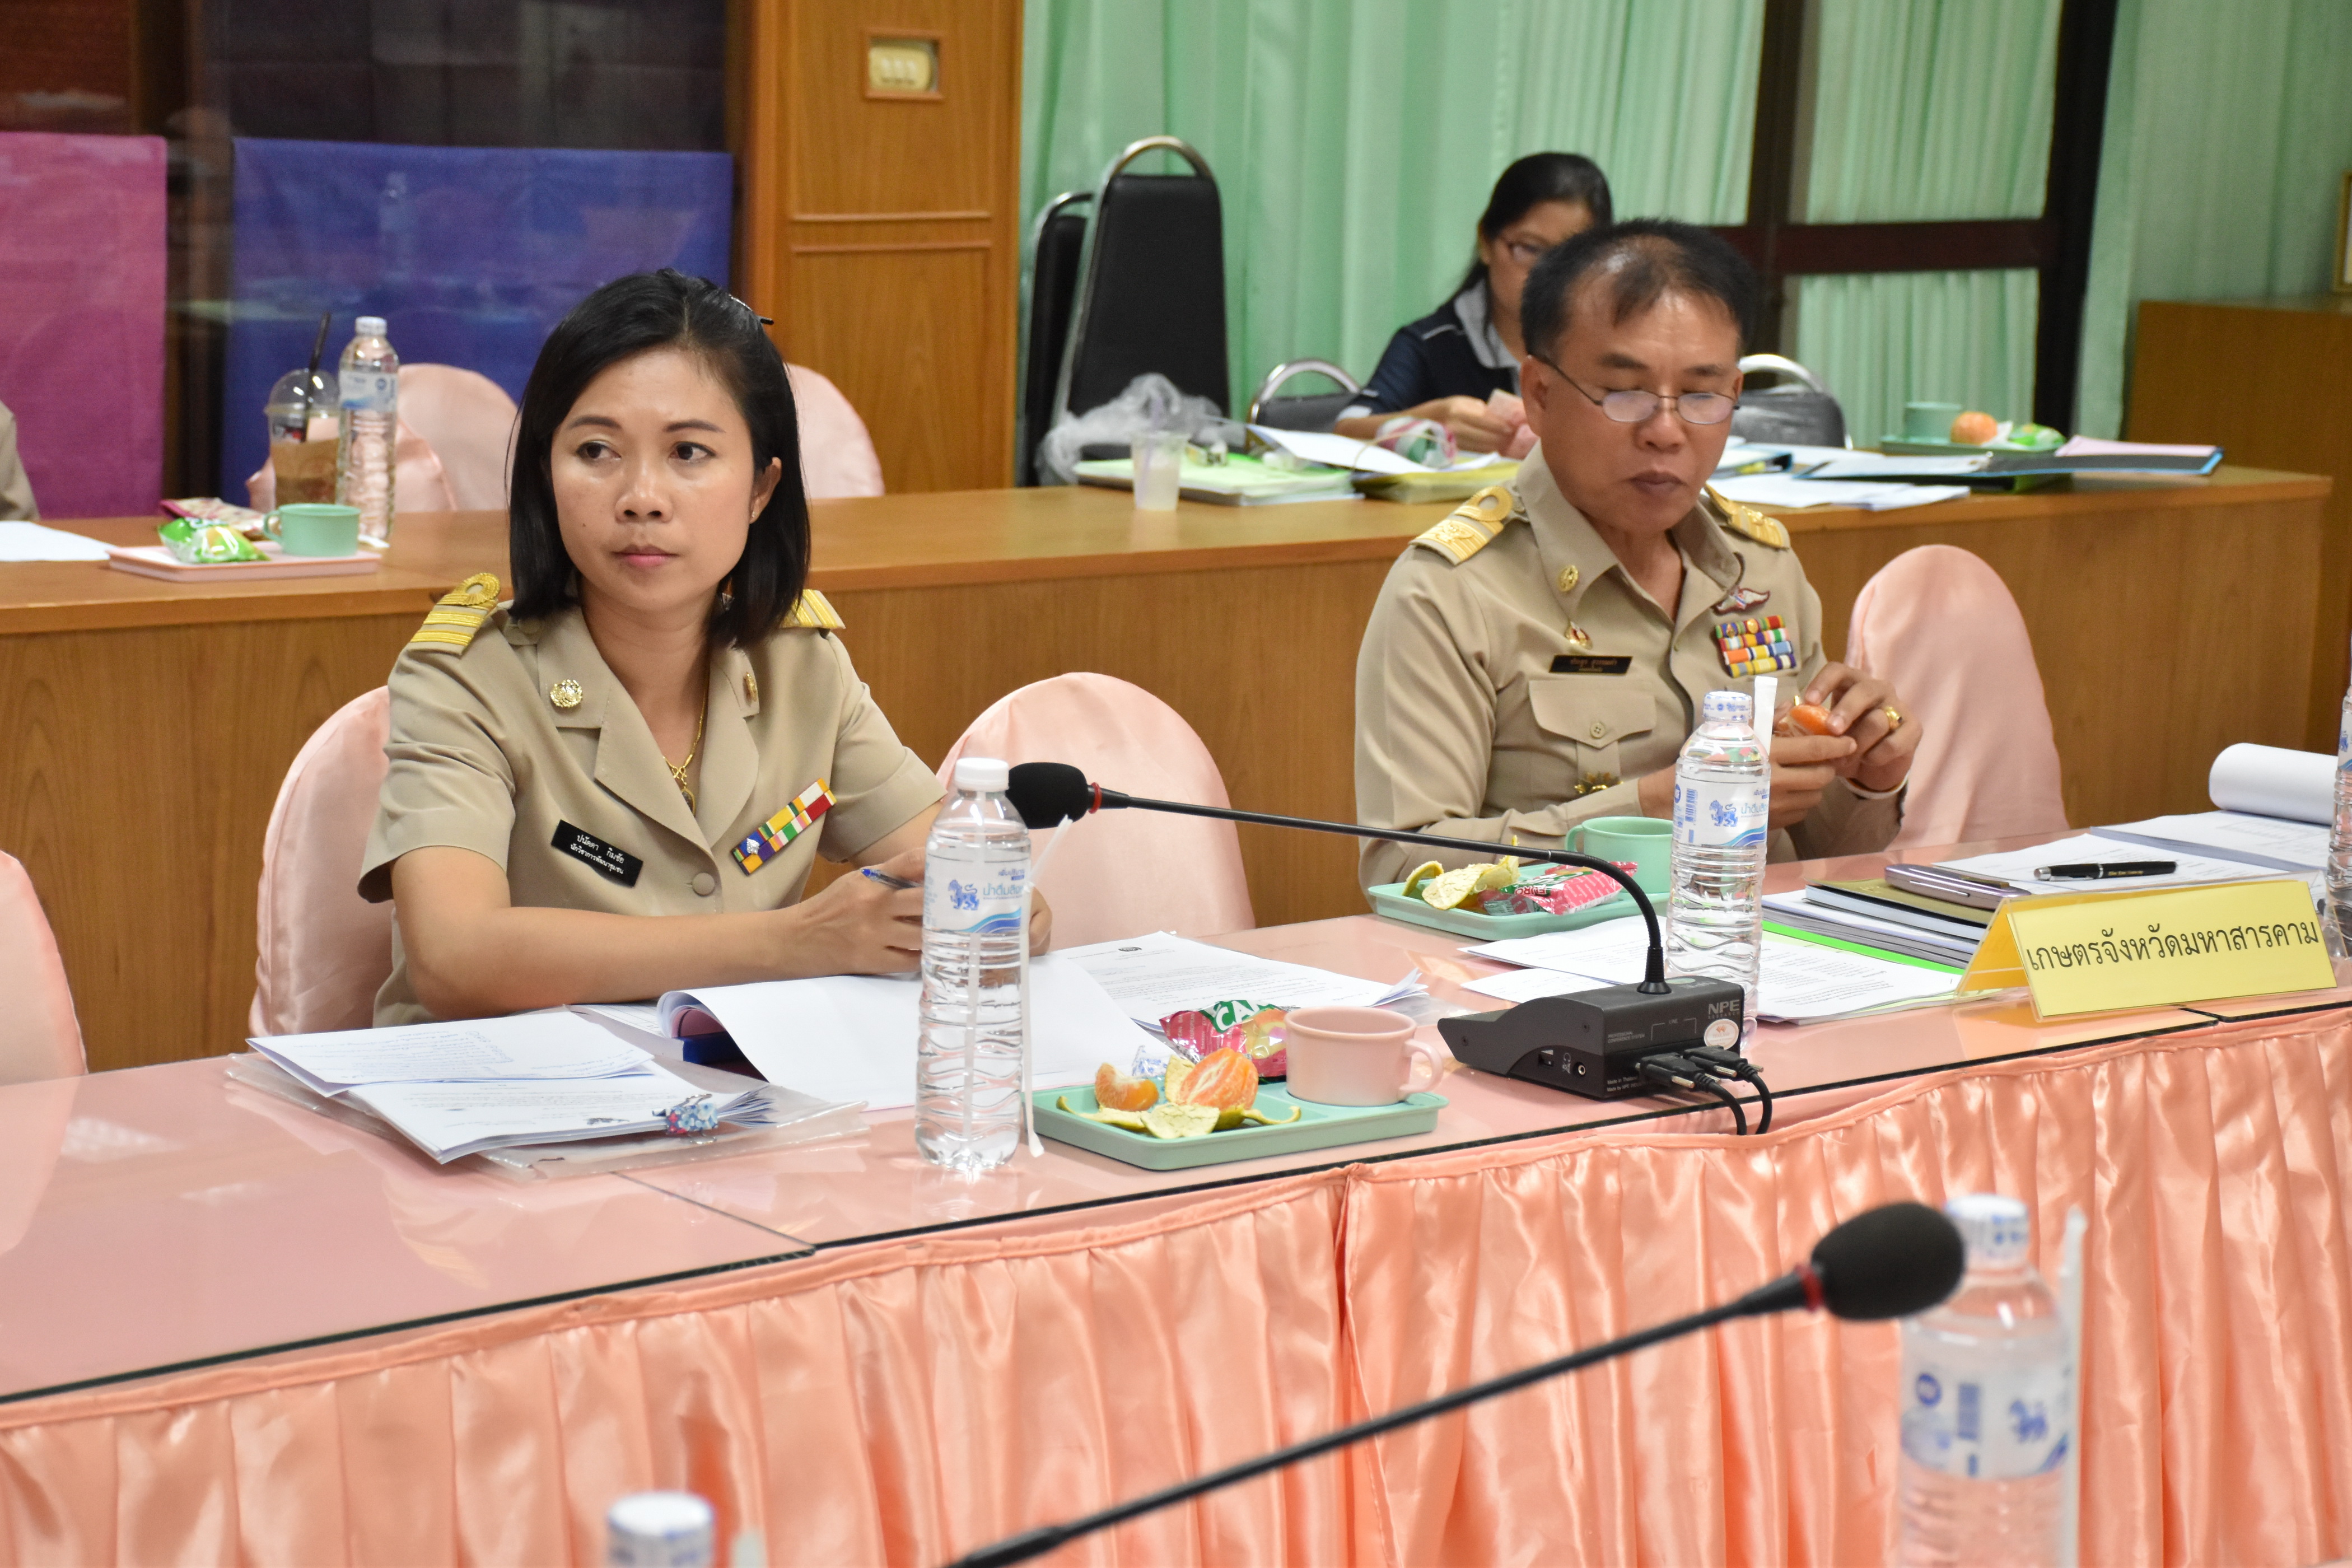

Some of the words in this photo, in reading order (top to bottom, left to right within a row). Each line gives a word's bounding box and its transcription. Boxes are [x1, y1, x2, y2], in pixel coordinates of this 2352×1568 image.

[2026, 921, 2320, 970] เกษตรจังหวัดมหาสารคาม
[1708, 1000, 1740, 1015] NPE
